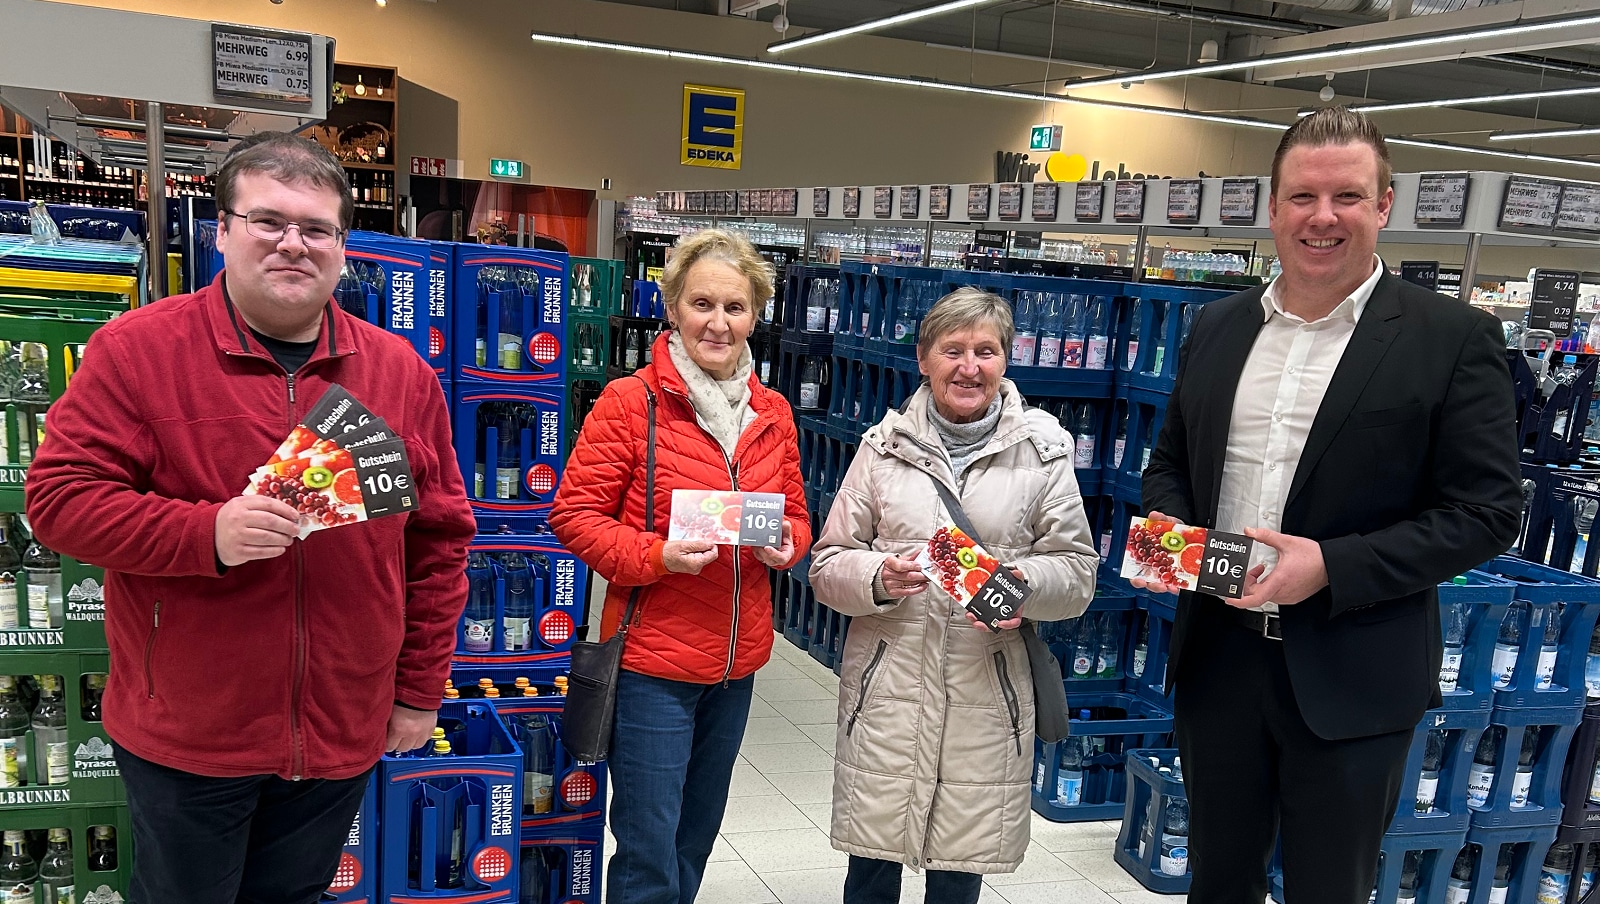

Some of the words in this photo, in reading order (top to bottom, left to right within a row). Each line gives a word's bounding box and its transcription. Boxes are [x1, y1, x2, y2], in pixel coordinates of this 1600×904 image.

[217, 41, 268, 57] MEHRWEG
[286, 50, 308, 62] 6.99
[217, 69, 268, 85] MEHRWEG
[286, 78, 308, 89] 0.75
[688, 92, 736, 148] E
[688, 148, 734, 162] EDEKA
[996, 150, 1041, 183] Wir
[1510, 188, 1538, 197] MEHRWEG
[1564, 194, 1591, 203] MEHRWEG
[1505, 208, 1532, 218] MEHRWEG
[1541, 212, 1554, 220] 0.79
[1560, 213, 1586, 222] MEHRWEG
[1417, 271, 1434, 279] 4.14
[1554, 282, 1574, 290] 4.74
[392, 271, 402, 329] FRANKEN
[403, 272, 414, 329] BRUNNEN
[436, 270, 445, 317] BRUNNEN
[544, 277, 552, 323] FRANKEN
[552, 277, 561, 323] BRUNNEN
[1550, 321, 1568, 330] EINWEG
[317, 398, 352, 434] Gutschein
[541, 411, 550, 455] FRANKEN
[550, 412, 558, 455] BRUNNEN
[359, 451, 402, 468] Gutschein
[746, 499, 780, 510] Gutschein
[1210, 538, 1246, 554] Gutschein
[556, 560, 566, 606] FRANKEN
[565, 560, 575, 606] BRUNNEN
[994, 572, 1024, 600] Gutschein
[72, 769, 120, 778] WALDQUELLE
[492, 785, 502, 836] FRANKEN
[502, 784, 513, 835] BRUNNEN
[572, 850, 582, 896] FRANKEN
[581, 849, 592, 895] BRUNNEN
